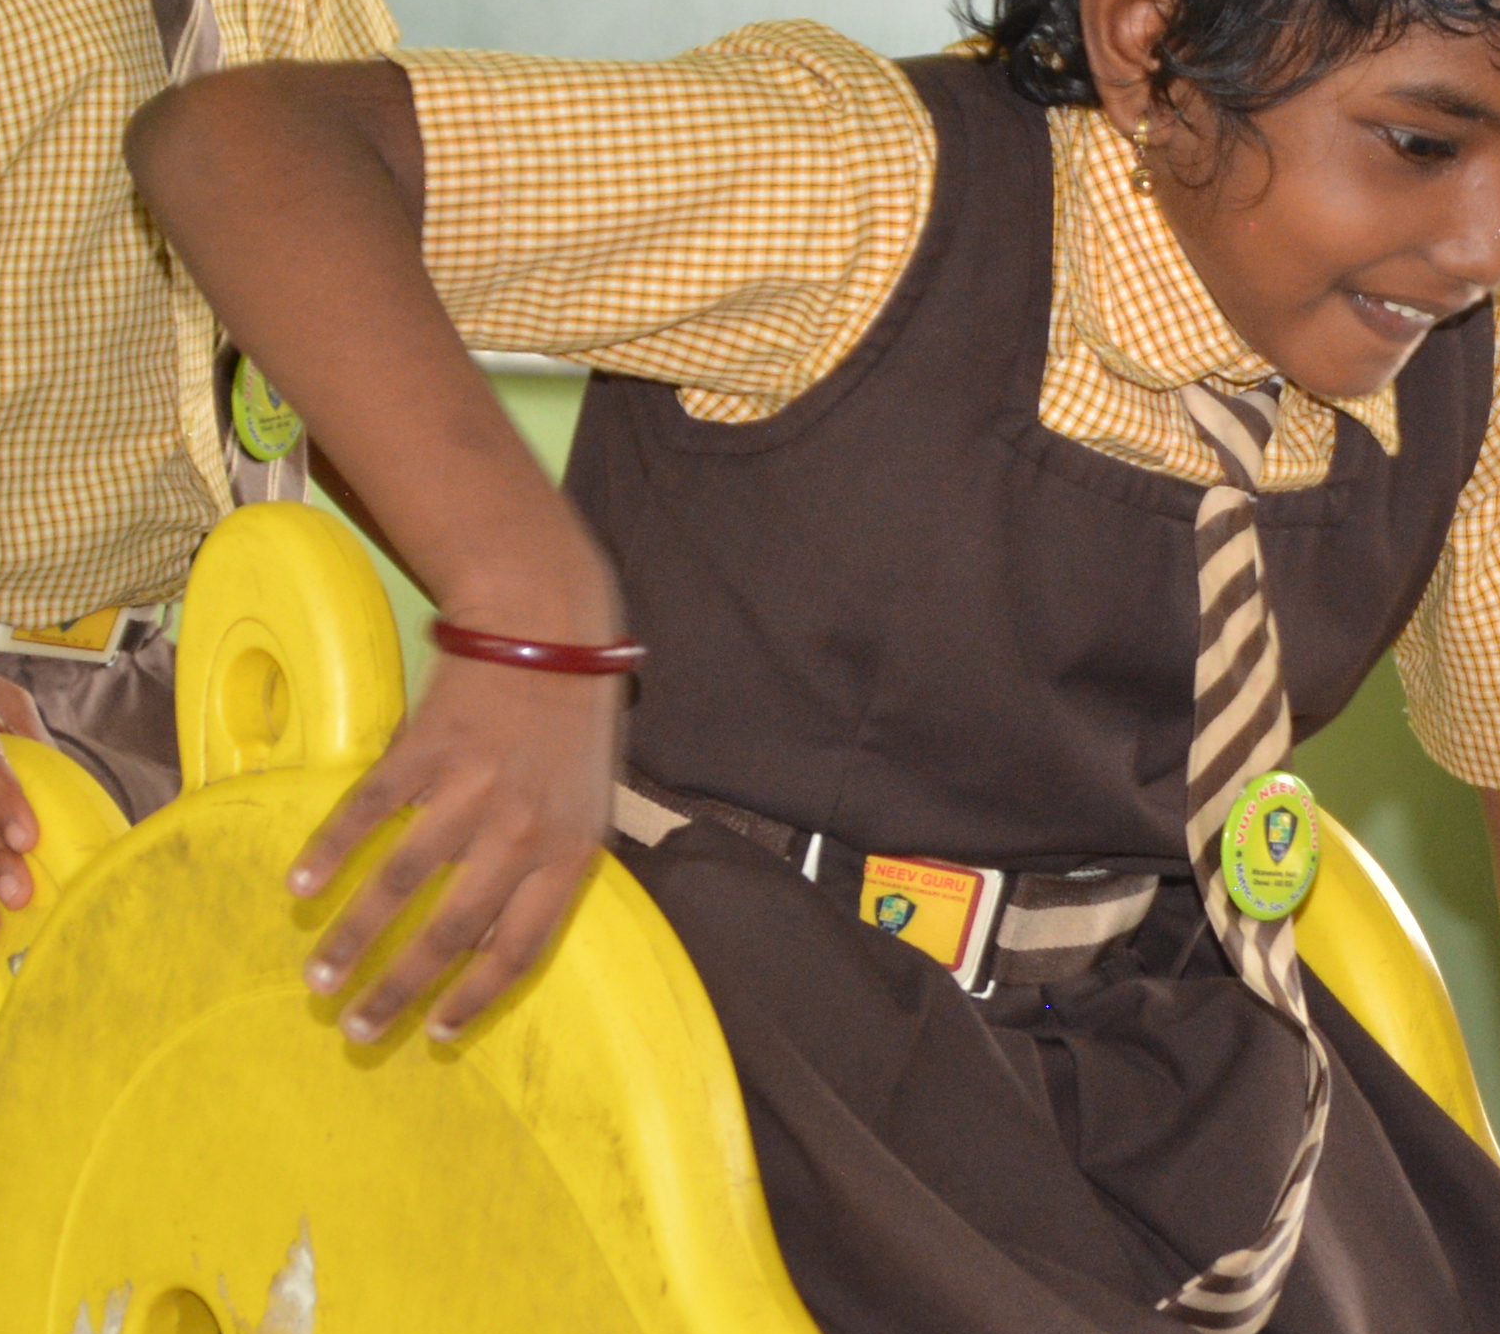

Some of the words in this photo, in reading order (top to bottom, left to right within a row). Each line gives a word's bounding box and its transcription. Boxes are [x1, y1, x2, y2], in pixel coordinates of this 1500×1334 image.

[1235, 801, 1258, 845] VUG
[1259, 781, 1299, 801] NEEV
[875, 863, 918, 883] NEEV
[920, 872, 967, 893] GURU
